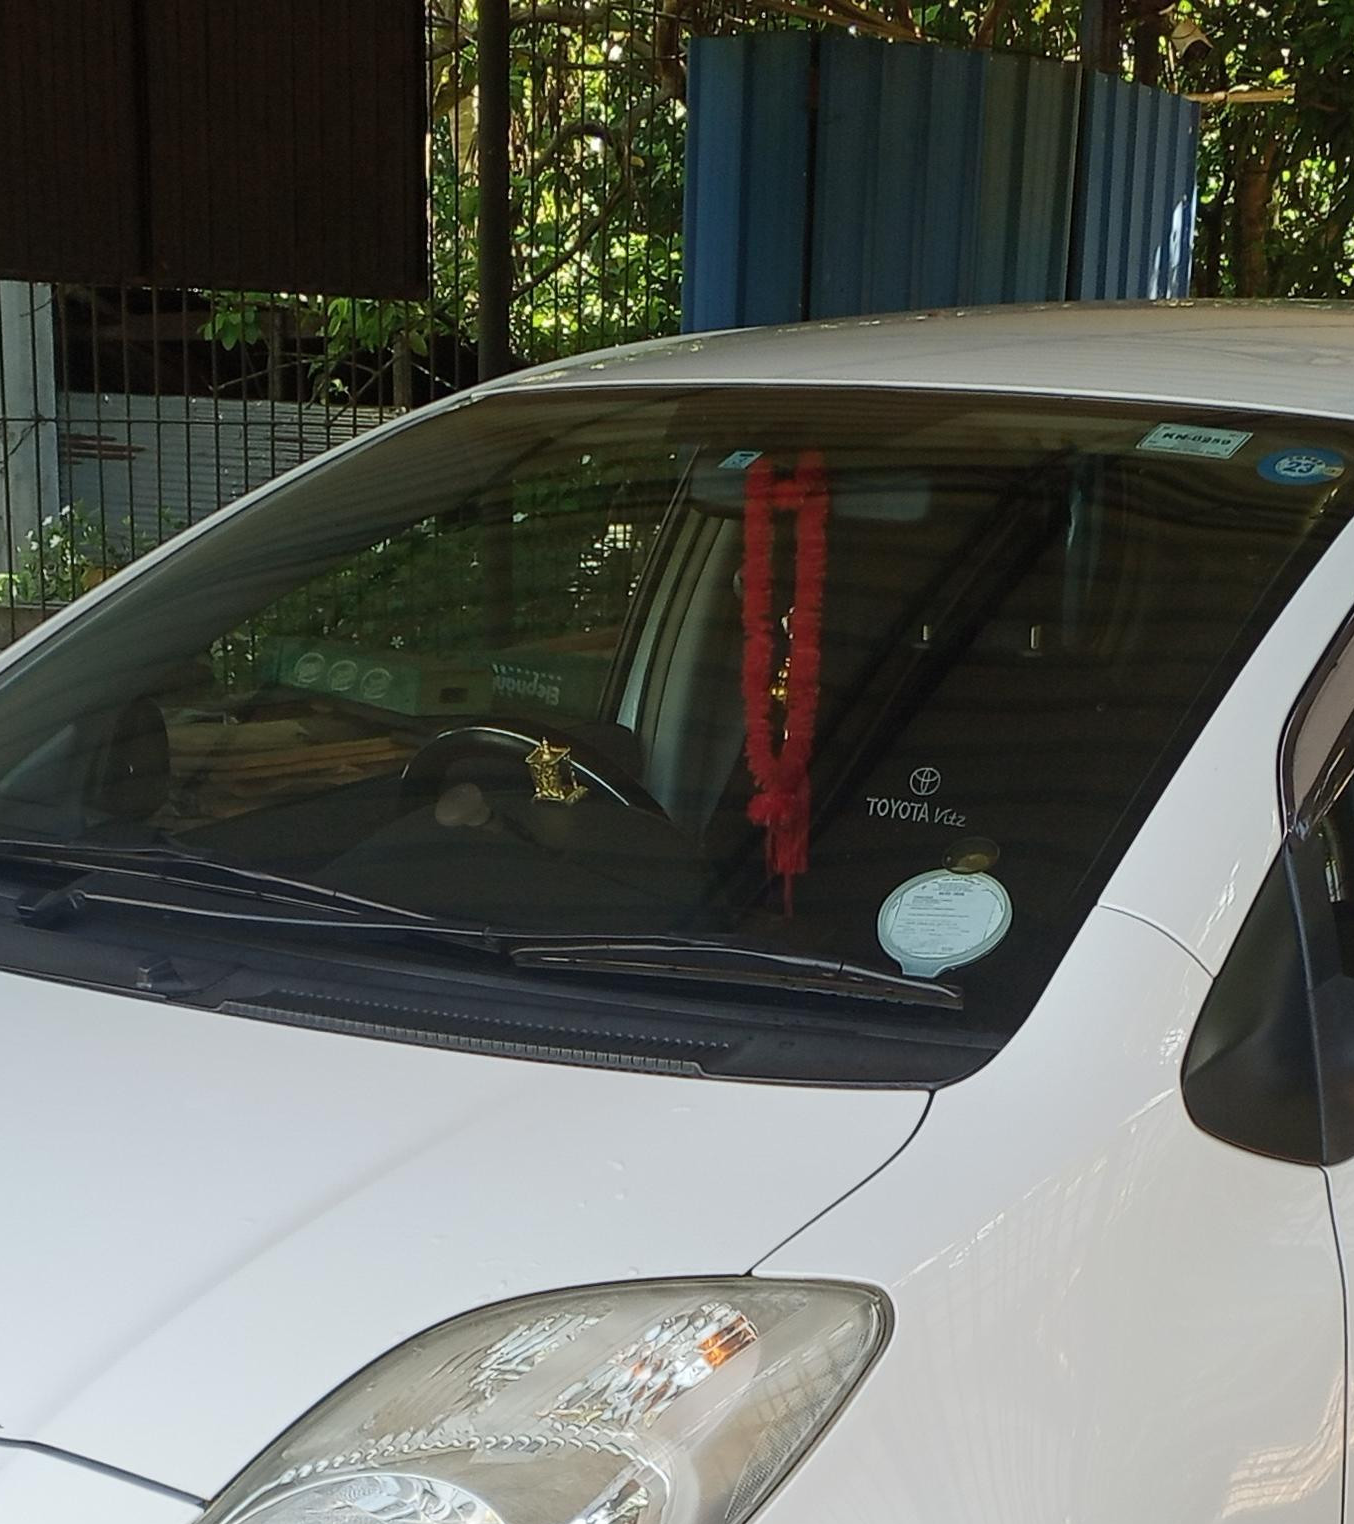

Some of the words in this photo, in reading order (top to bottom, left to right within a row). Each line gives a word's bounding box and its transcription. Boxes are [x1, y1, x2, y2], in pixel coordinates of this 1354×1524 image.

[1283, 461, 1315, 474] 23
[866, 797, 929, 822] TOYOTA
[934, 808, 966, 827] Vitz
